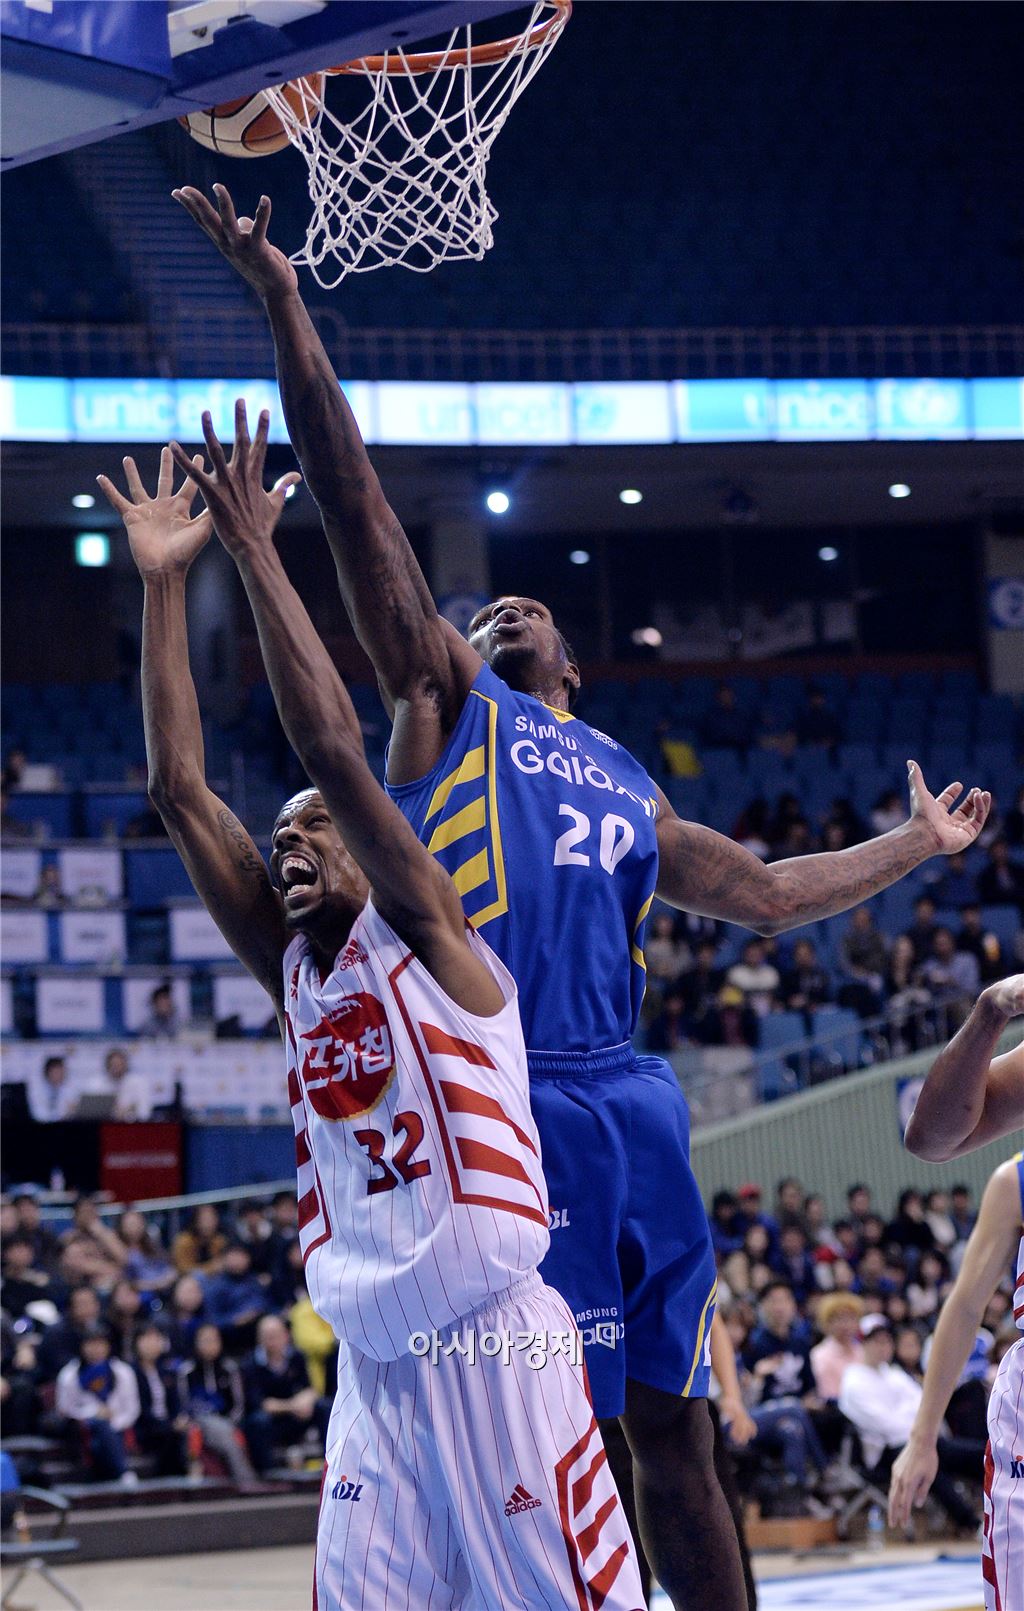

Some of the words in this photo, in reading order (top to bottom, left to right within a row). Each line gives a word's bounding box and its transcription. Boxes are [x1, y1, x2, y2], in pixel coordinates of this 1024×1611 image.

[514, 715, 598, 766] SAMSU
[555, 804, 635, 875] 20
[354, 1111, 431, 1195] 32
[549, 1208, 571, 1230] BL
[576, 1307, 618, 1323] MSUNG
[504, 1497, 542, 1517] adidas
